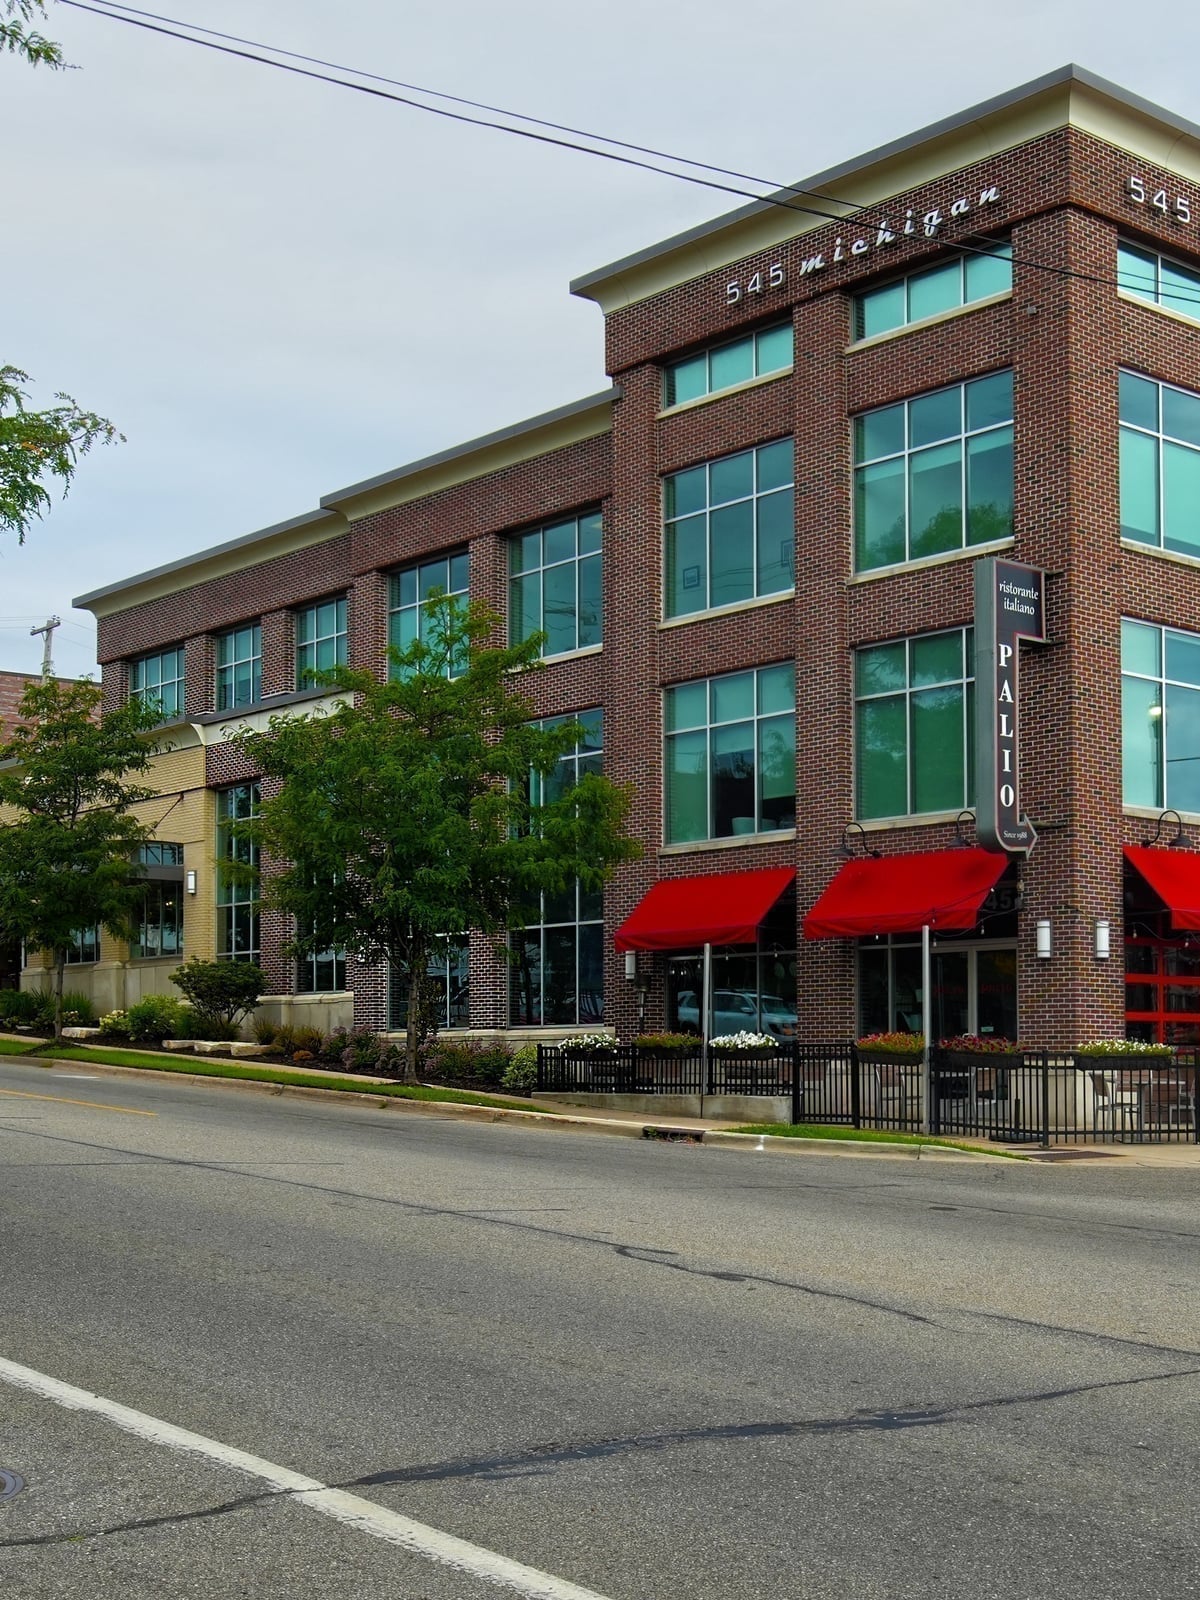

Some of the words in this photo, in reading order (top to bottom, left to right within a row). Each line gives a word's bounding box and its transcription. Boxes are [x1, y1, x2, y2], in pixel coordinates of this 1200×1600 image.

[1127, 176, 1191, 224] 545
[726, 263, 787, 305] 545
[799, 184, 1001, 276] michigan
[999, 580, 1039, 600] ristorante
[1003, 597, 1035, 616] italiano
[998, 643, 1014, 808] PALIO
[1003, 830, 1016, 839] Since
